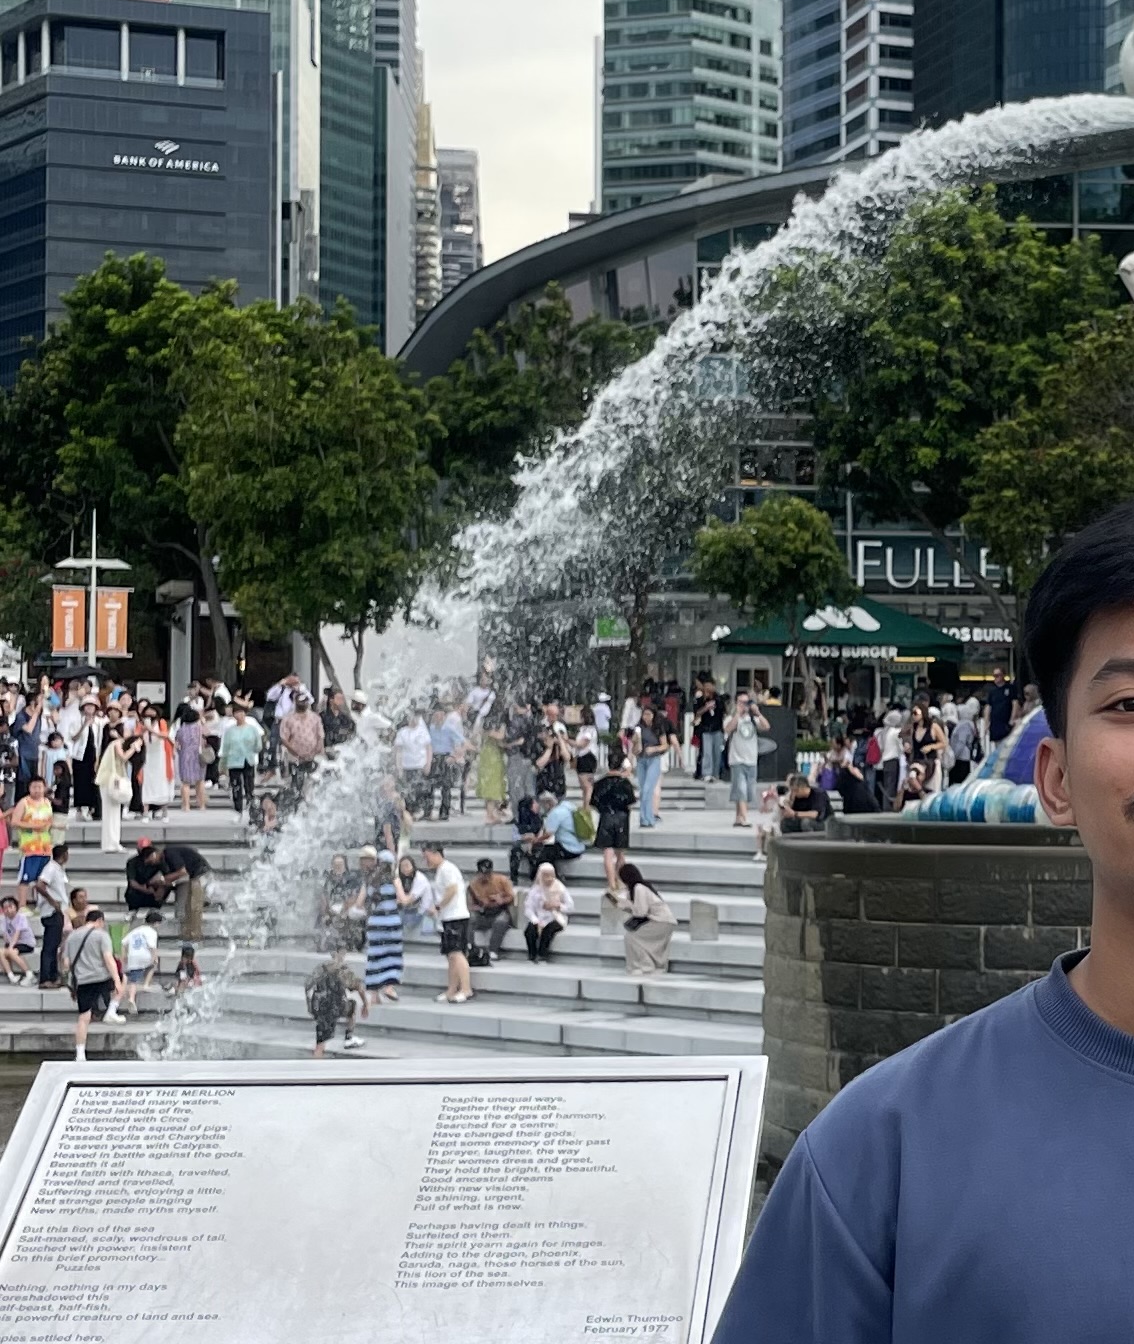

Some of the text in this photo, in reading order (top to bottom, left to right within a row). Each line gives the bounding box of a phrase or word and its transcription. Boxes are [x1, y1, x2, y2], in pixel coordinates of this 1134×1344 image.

[113, 154, 220, 173] BANK OF AMERICA
[806, 645, 898, 658] MOS BURGER
[441, 1096, 532, 1104] Despite unequal
[440, 1104, 516, 1113] Together they
[437, 1113, 480, 1122] Explore
[503, 1113, 538, 1121] edges
[148, 1124, 187, 1133] squeal
[105, 1134, 140, 1142] Scylla
[167, 1133, 225, 1142] Charybdis
[463, 1131, 513, 1139] changed
[110, 1143, 142, 1151] years
[430, 1140, 457, 1148] Kept
[493, 1140, 540, 1148] memory
[147, 1151, 191, 1160] against
[51, 1170, 78, 1178] kept
[424, 1166, 451, 1175] They
[37, 1188, 184, 1197] Suffering enjoying
[58, 1197, 103, 1206] strange
[105, 1197, 146, 1206] people
[148, 1197, 192, 1205] singing
[137, 1206, 174, 1215] myths
[408, 1222, 456, 1231] Perhaps
[459, 1222, 499, 1231] having
[505, 1241, 538, 1249] again
[400, 1251, 443, 1259] Adding
[52, 1283, 167, 1292] nothing days
[421, 1280, 459, 1289] image
[14, 1314, 70, 1322] powerful
[582, 1325, 637, 1334] February
